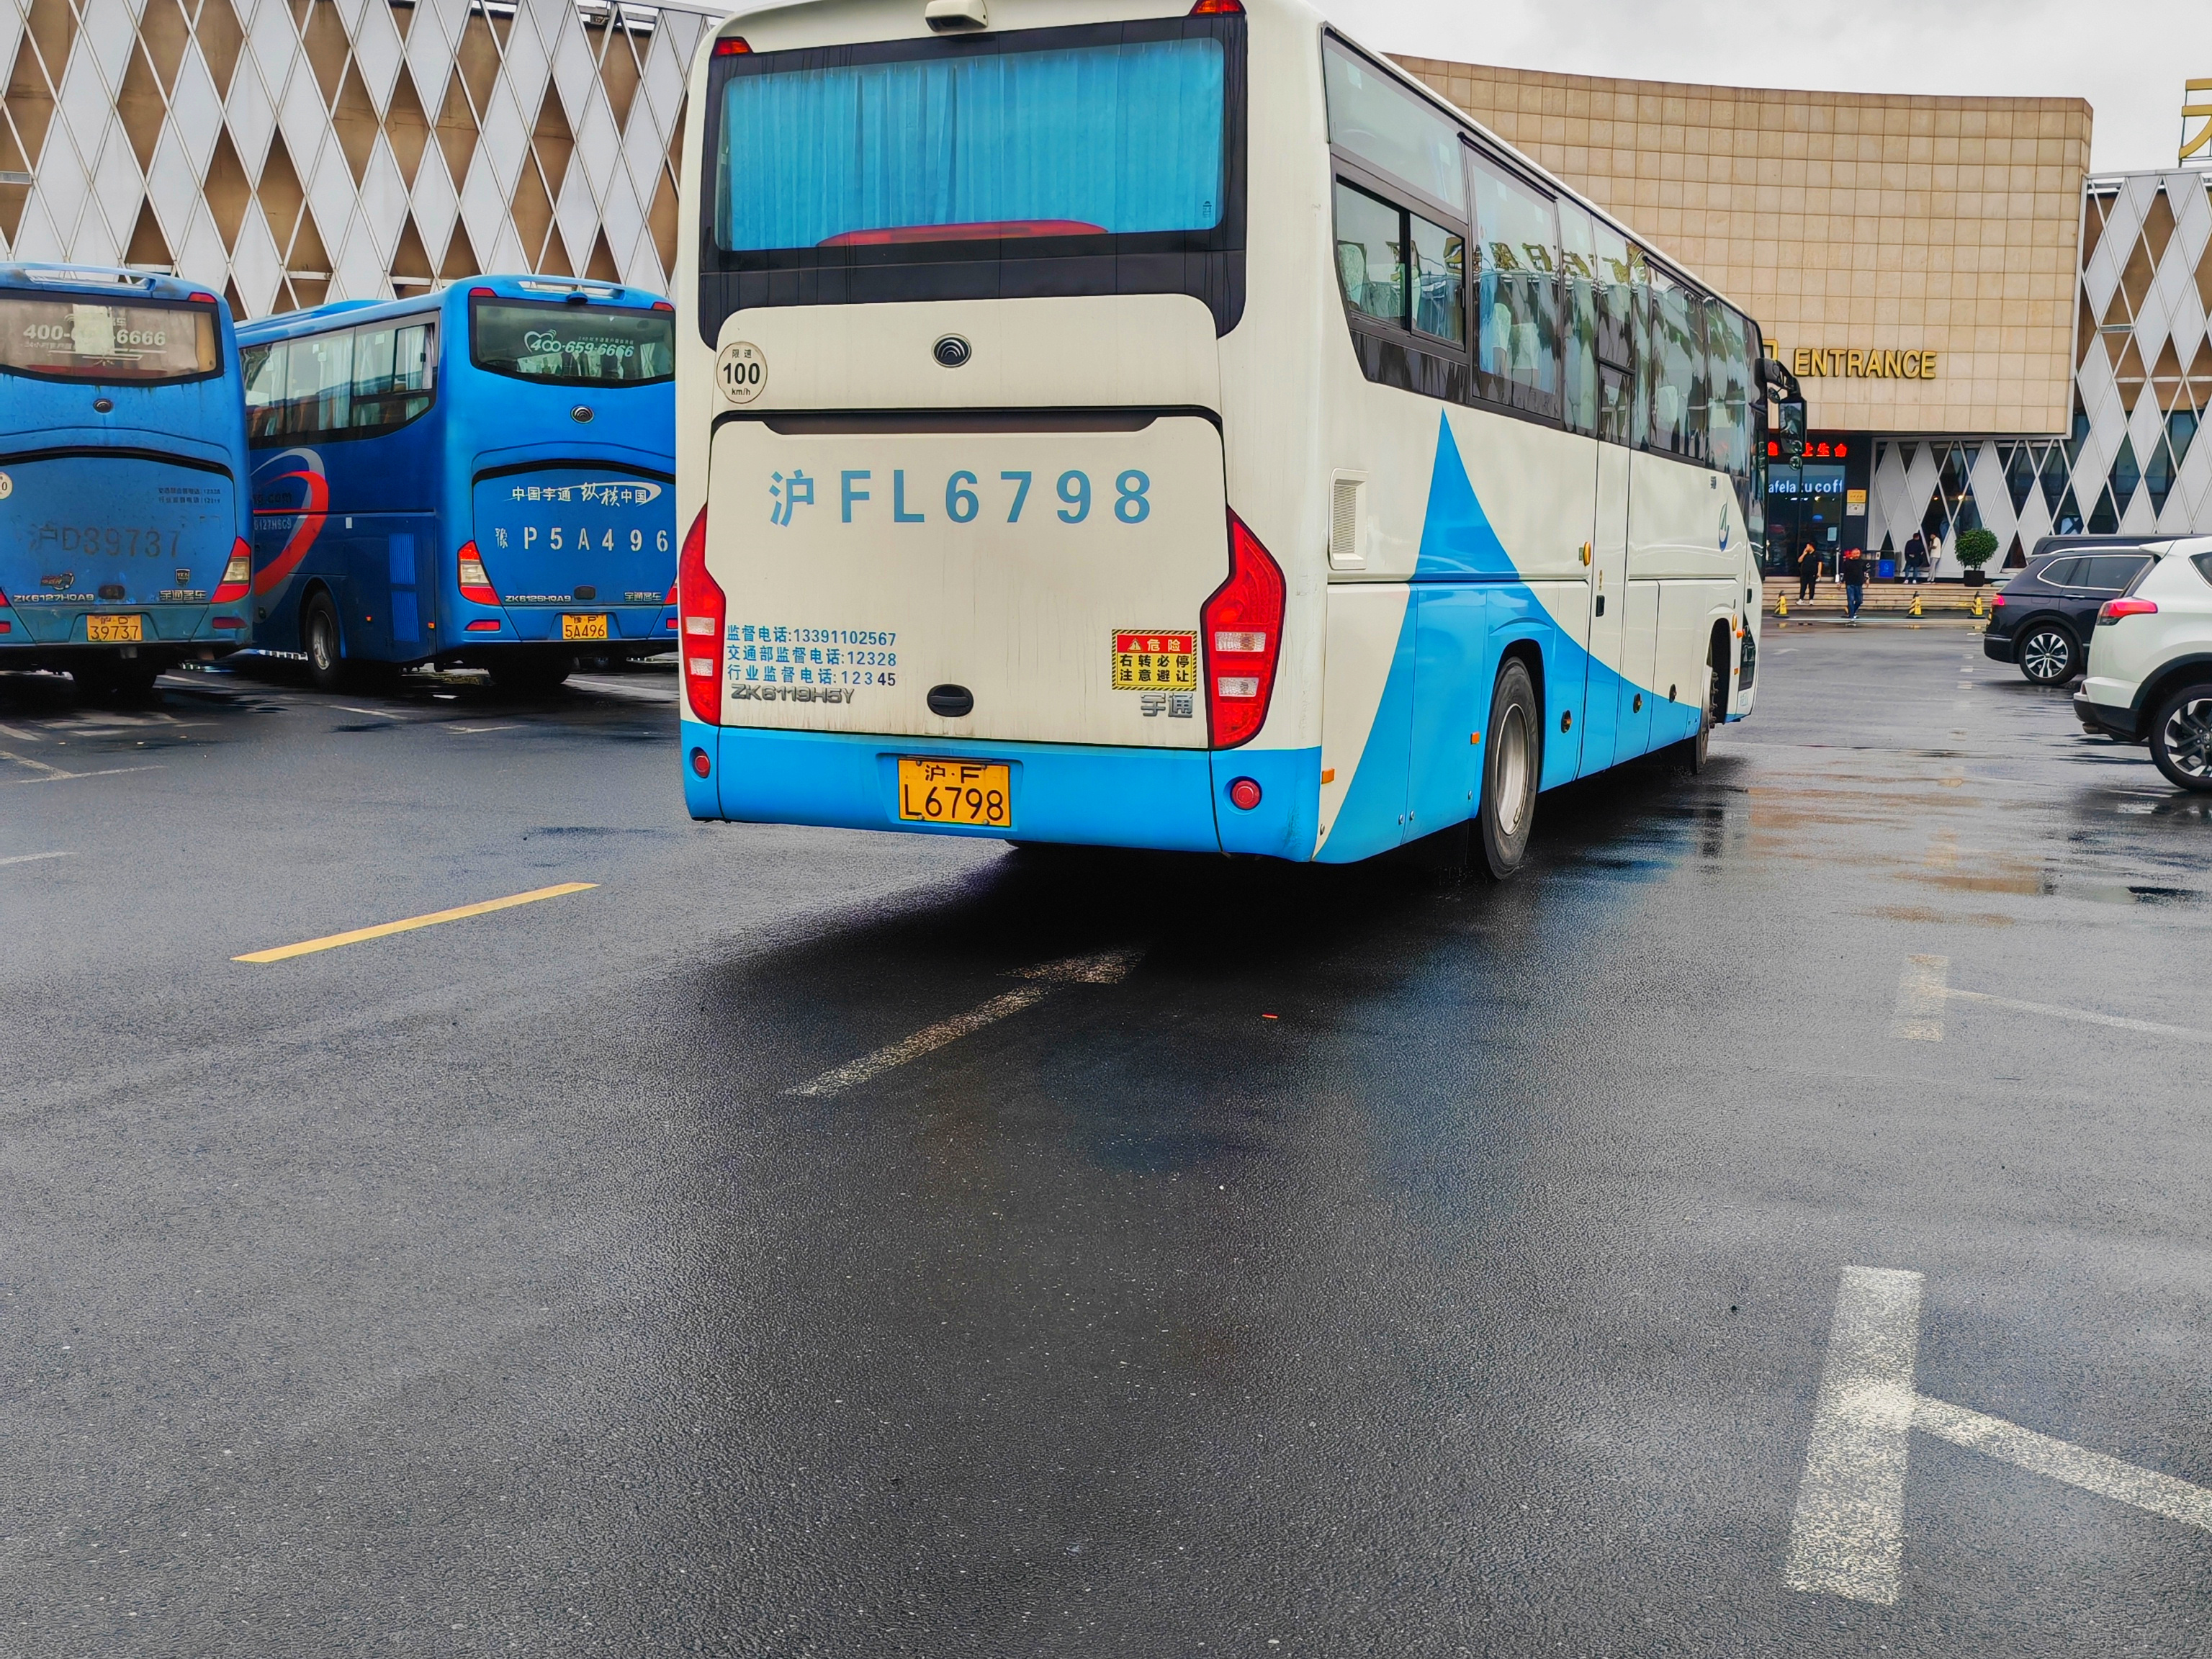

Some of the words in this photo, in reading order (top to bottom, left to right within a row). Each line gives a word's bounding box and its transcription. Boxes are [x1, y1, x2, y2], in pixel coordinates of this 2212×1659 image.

[1794, 349, 1936, 379] ENTRANCE
[723, 362, 760, 385] 100
[512, 486, 572, 502] 中国宇通
[90, 626, 138, 639] 39737
[565, 624, 605, 637] 5A496
[1147, 639, 1181, 652] 危险
[1120, 654, 1190, 668] 右转必停
[1120, 669, 1190, 682] 注意避让
[731, 683, 855, 704] ZK6119H5Y
[1141, 692, 1193, 718] 宇通
[904, 783, 1004, 821] L6798
